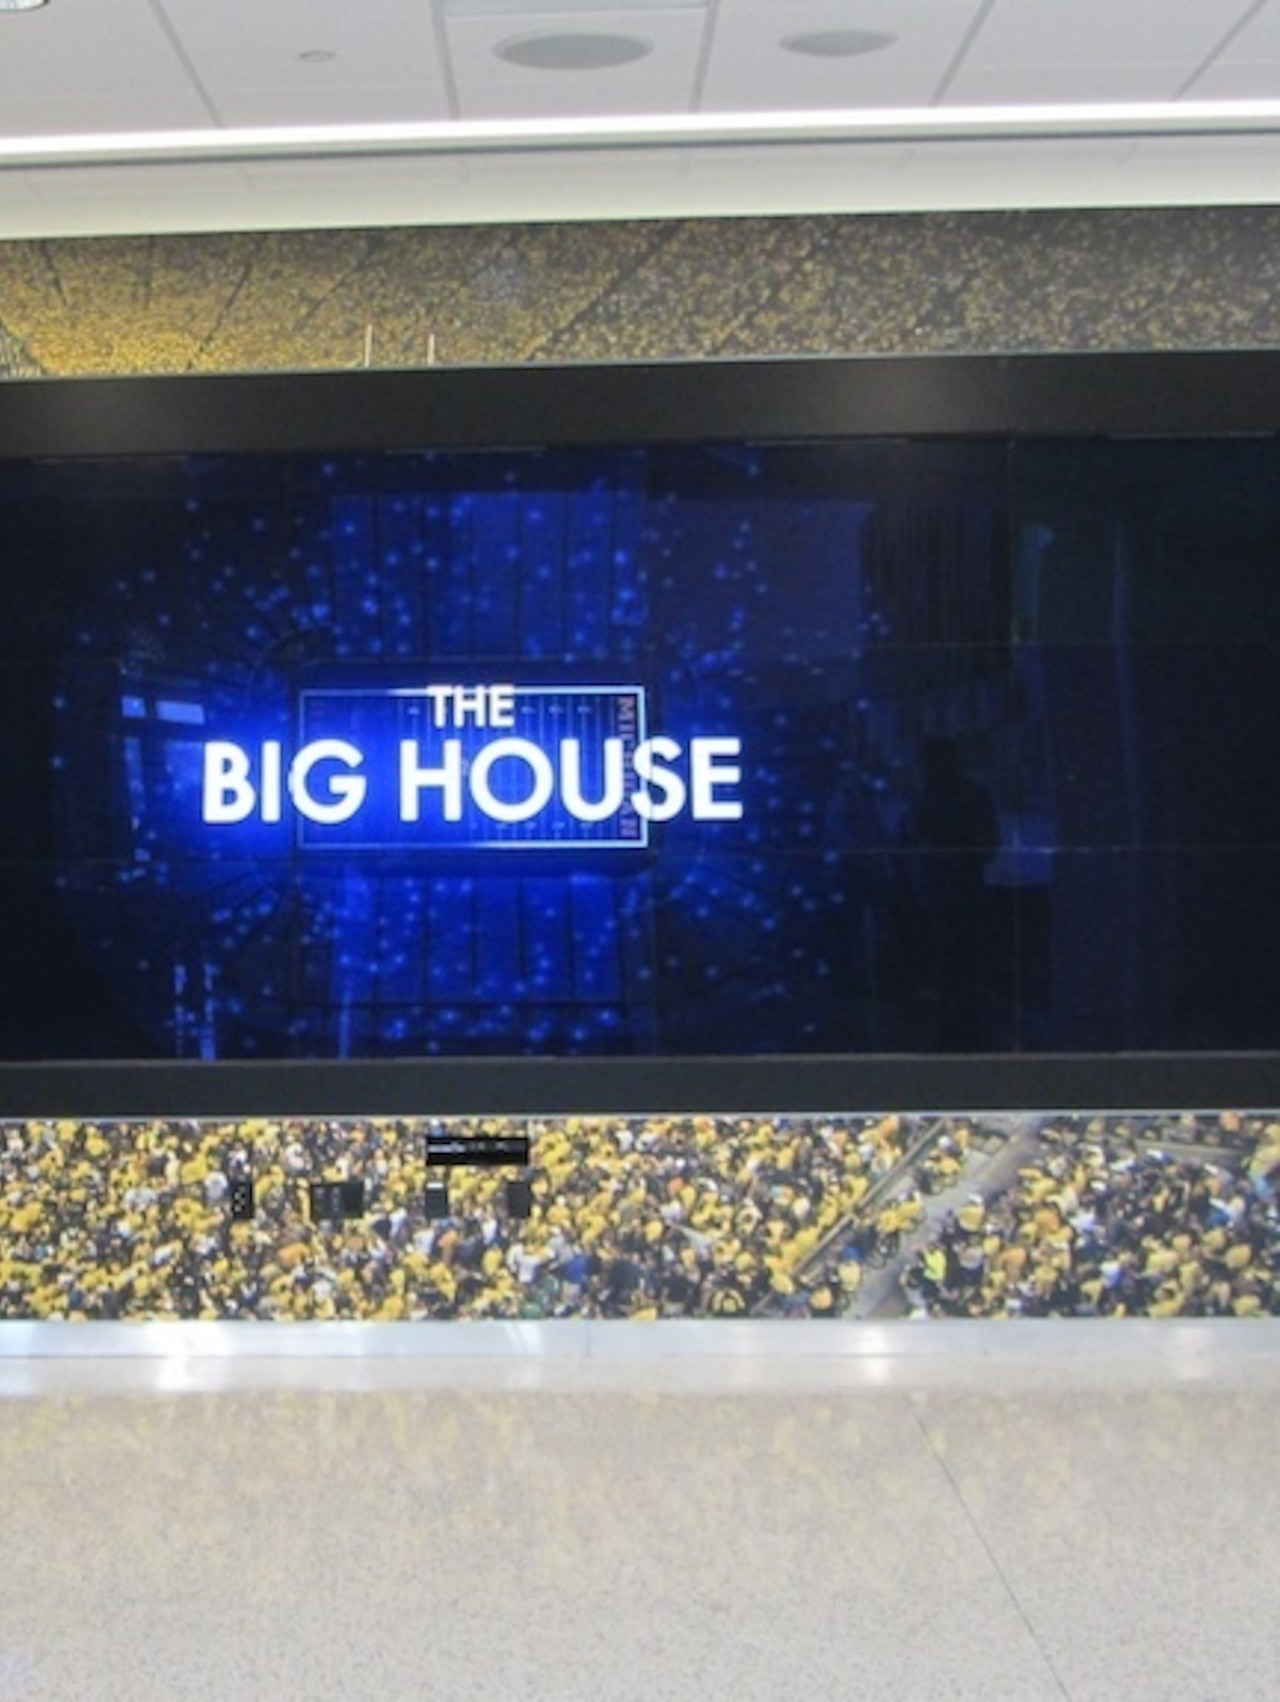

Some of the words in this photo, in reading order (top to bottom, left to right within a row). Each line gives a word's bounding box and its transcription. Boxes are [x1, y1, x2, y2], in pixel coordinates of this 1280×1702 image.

[424, 684, 519, 728] THE
[202, 738, 367, 824] BIG
[399, 736, 743, 822] HOUSE
